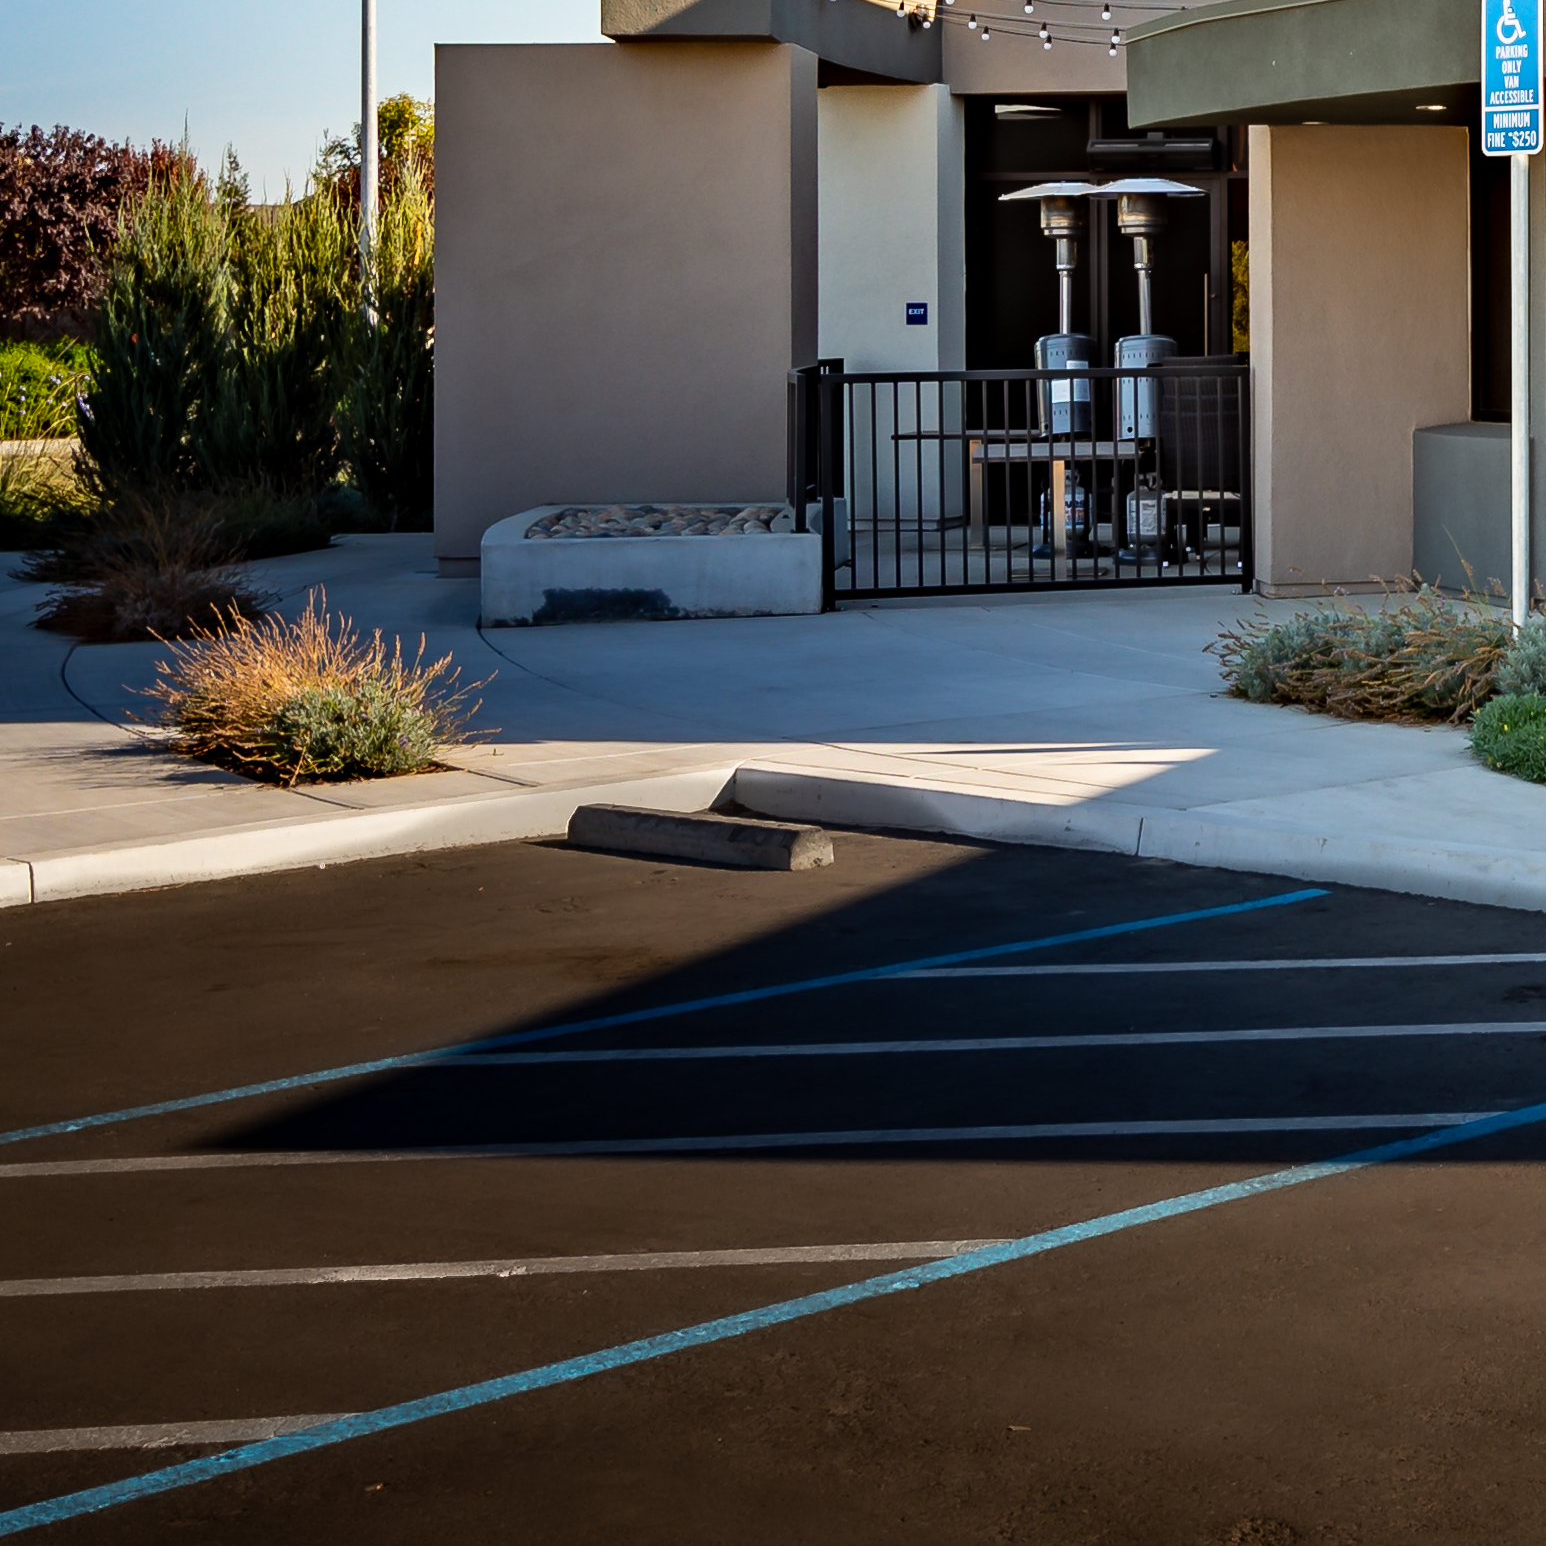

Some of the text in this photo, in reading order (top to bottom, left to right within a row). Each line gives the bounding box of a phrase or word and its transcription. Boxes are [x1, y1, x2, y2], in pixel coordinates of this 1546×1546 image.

[1495, 44, 1528, 59] PARKING
[1501, 60, 1522, 75] ONLY
[1504, 75, 1519, 89] VAN
[1489, 89, 1534, 105] ACCESSIBLE
[1493, 112, 1530, 129] MINIMUM
[1487, 130, 1537, 148] FINE $250
